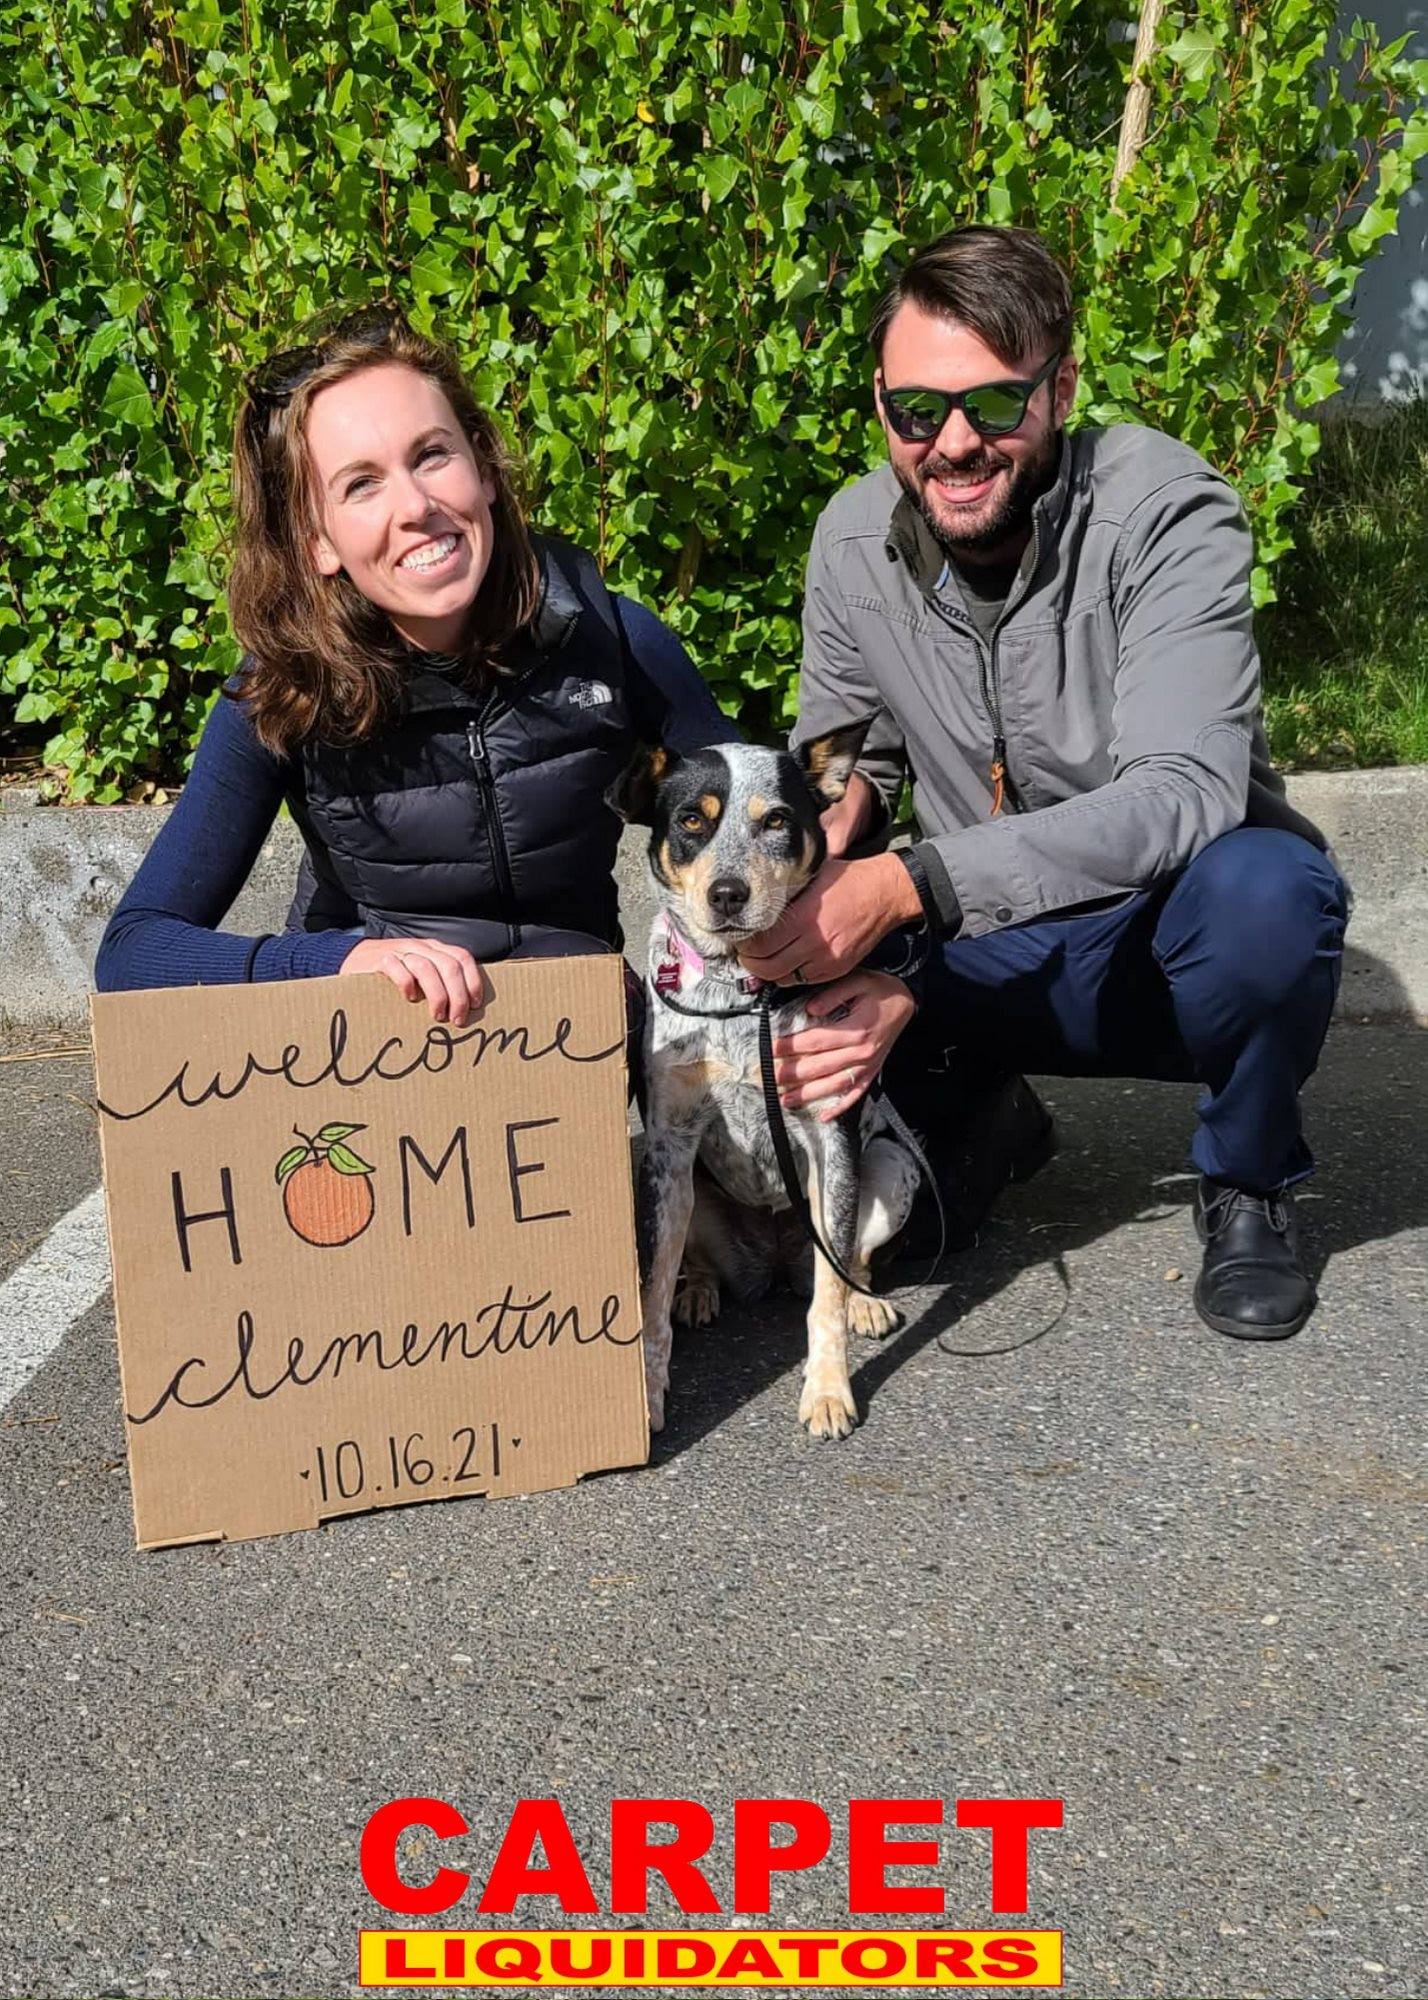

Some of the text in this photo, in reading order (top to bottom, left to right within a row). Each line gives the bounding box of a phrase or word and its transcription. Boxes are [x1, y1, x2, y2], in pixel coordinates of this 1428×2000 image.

[97, 1008, 626, 1120] welcome
[128, 1285, 643, 1424] clementine
[316, 1423, 500, 1501] 10.16.21
